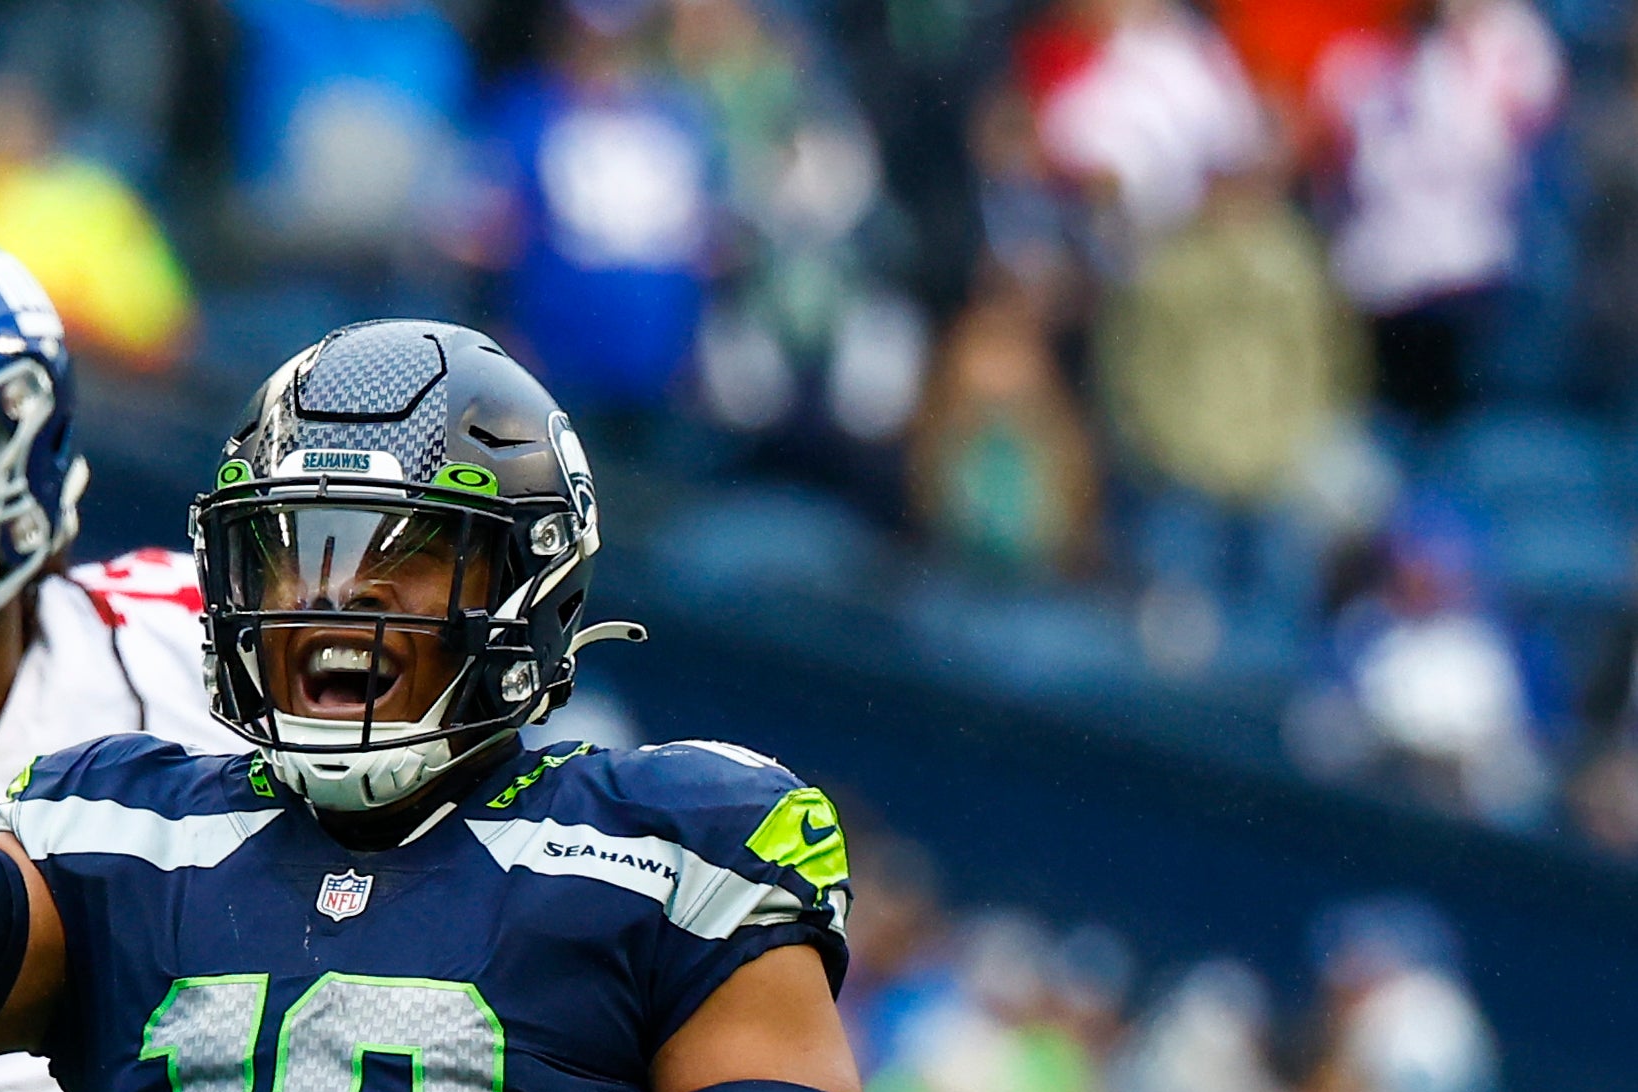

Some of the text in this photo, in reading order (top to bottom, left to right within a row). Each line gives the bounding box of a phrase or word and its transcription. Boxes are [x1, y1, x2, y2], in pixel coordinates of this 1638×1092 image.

[302, 451, 371, 473] SEAHAWKS
[543, 841, 680, 889] SEAHAWK
[325, 891, 358, 912] NFL
